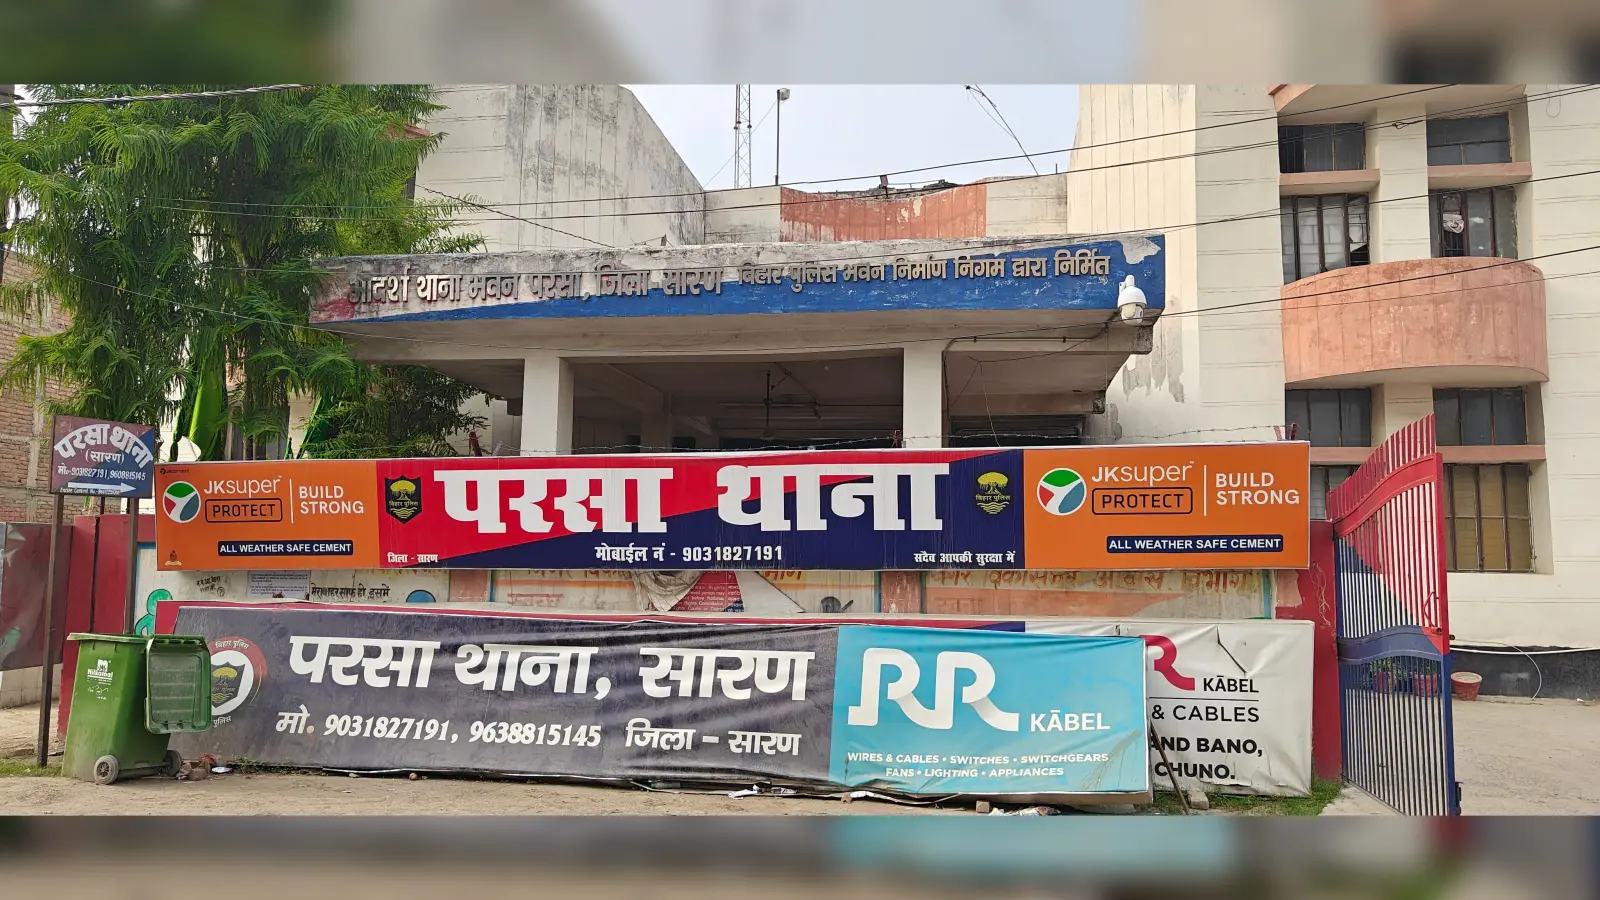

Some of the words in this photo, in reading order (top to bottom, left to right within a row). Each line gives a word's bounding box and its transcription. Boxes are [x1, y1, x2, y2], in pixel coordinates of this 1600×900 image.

[416, 274, 462, 301] थाना
[468, 273, 520, 299] भवन
[738, 262, 785, 286] बिहार
[788, 260, 839, 292] पुलिस
[843, 263, 886, 283] भवन
[892, 253, 947, 281] निर्माण
[953, 253, 1005, 279] निगम
[1011, 255, 1047, 278] द्वारा
[1053, 249, 1111, 276] निर्मित
[54, 424, 110, 458] परसा
[110, 425, 154, 469] थाना
[1215, 472, 1274, 488] BUILD
[299, 485, 344, 499] BUILD
[434, 468, 673, 534] परसा
[716, 463, 949, 531] थाना
[1216, 489, 1300, 505] STRONG
[300, 501, 364, 515] STRONG
[1102, 494, 1184, 508] PROTECT
[212, 503, 276, 517] PROTECT
[220, 544, 238, 553] ALL
[239, 543, 285, 553] WEATHER
[286, 543, 311, 553] SAFE
[313, 543, 352, 553] CEMENT
[1109, 540, 1132, 549] ALL
[1134, 539, 1193, 549] WEATHER
[1196, 539, 1228, 549] SAFE
[1230, 538, 1282, 548] CEMENT
[387, 552, 408, 563] जिला
[417, 554, 438, 563] सारण
[594, 542, 648, 564] मोबाईल
[652, 542, 666, 562] नं
[682, 545, 782, 562] 9031827191
[913, 550, 936, 563] सदैव
[940, 550, 973, 563] आपकी
[975, 553, 1003, 566] सुरक्षा
[1005, 550, 1016, 563] में
[289, 635, 441, 688] परसा
[454, 641, 611, 700] थाना,
[638, 647, 815, 701] सारण
[1203, 675, 1259, 693] KĀBEL
[1030, 709, 1110, 733] KĀBEL
[1151, 704, 1165, 720] &
[1173, 705, 1260, 722] CABLES
[323, 713, 458, 744] 9031827191,
[469, 720, 602, 748] 9638815145
[625, 717, 696, 752] जिला
[728, 730, 802, 756] सारण
[1196, 738, 1263, 757] BANO,
[848, 752, 883, 763] WIRES
[885, 753, 893, 763] &
[896, 753, 939, 764] CABLES
[949, 755, 1010, 765] SWITCHES
[1020, 753, 1109, 764] SWITCHGEARS
[886, 768, 914, 778] FANS
[924, 768, 978, 778] LIGHTING
[989, 767, 1064, 778] APPLIANCES
[1154, 762, 1236, 780] CHUNO.
